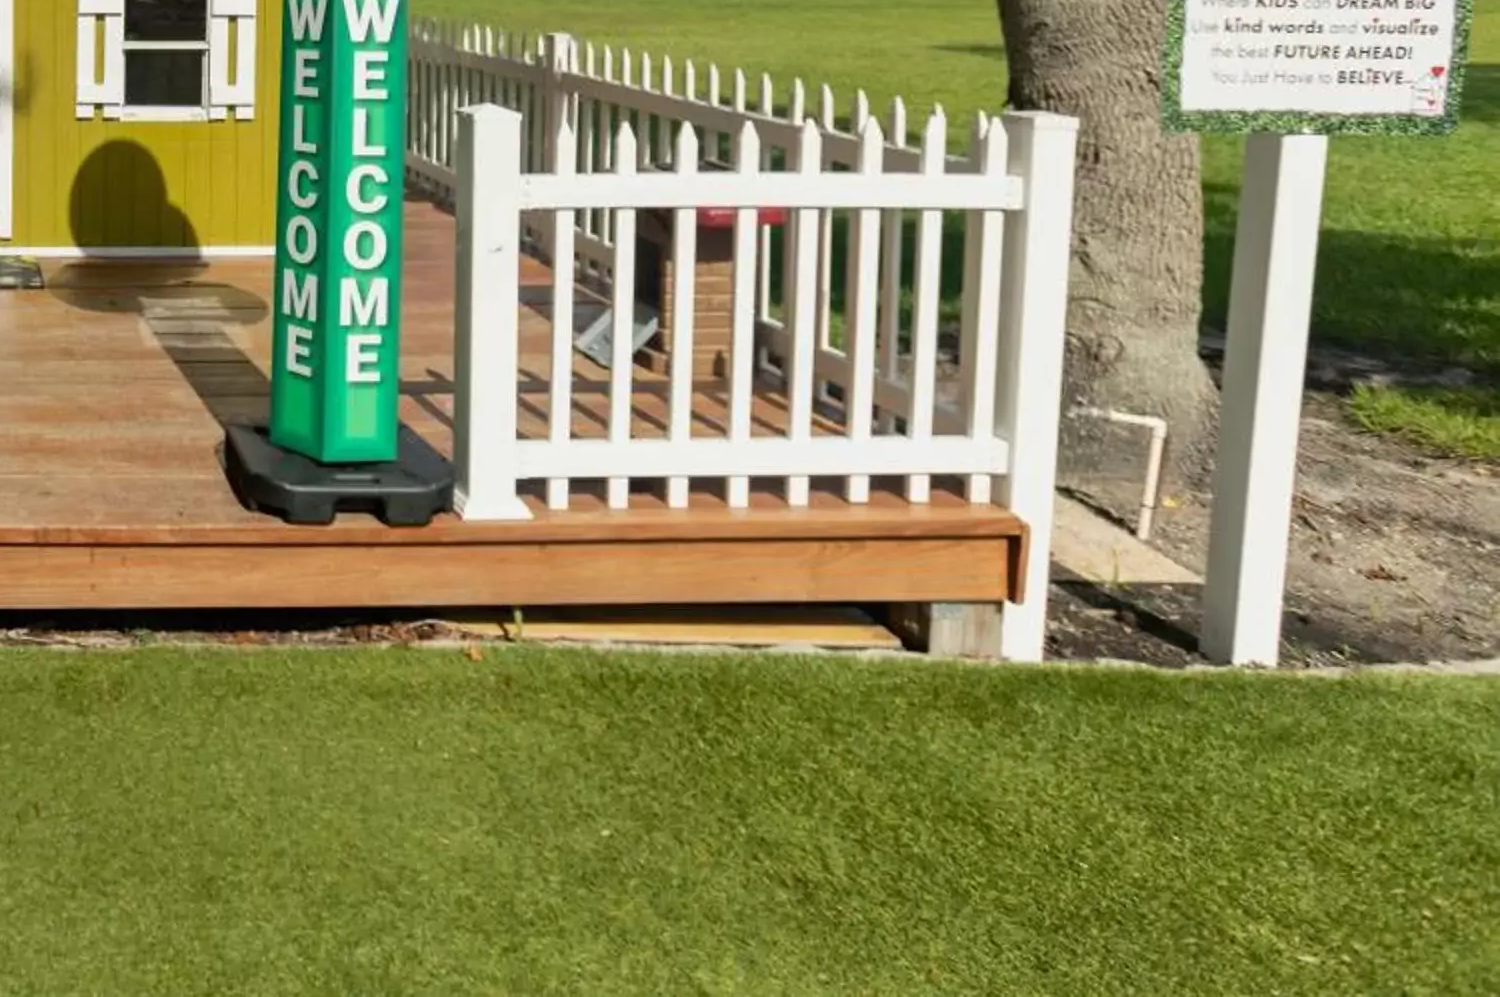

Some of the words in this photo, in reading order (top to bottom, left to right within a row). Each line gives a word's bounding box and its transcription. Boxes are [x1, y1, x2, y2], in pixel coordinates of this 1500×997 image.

[1224, 18, 1263, 34] kind
[1268, 19, 1324, 35] words
[1329, 19, 1358, 35] and
[1362, 18, 1439, 36] visualize
[1236, 45, 1271, 59] best
[1273, 46, 1341, 59] FUTURE
[1345, 46, 1413, 60] AHEAD!
